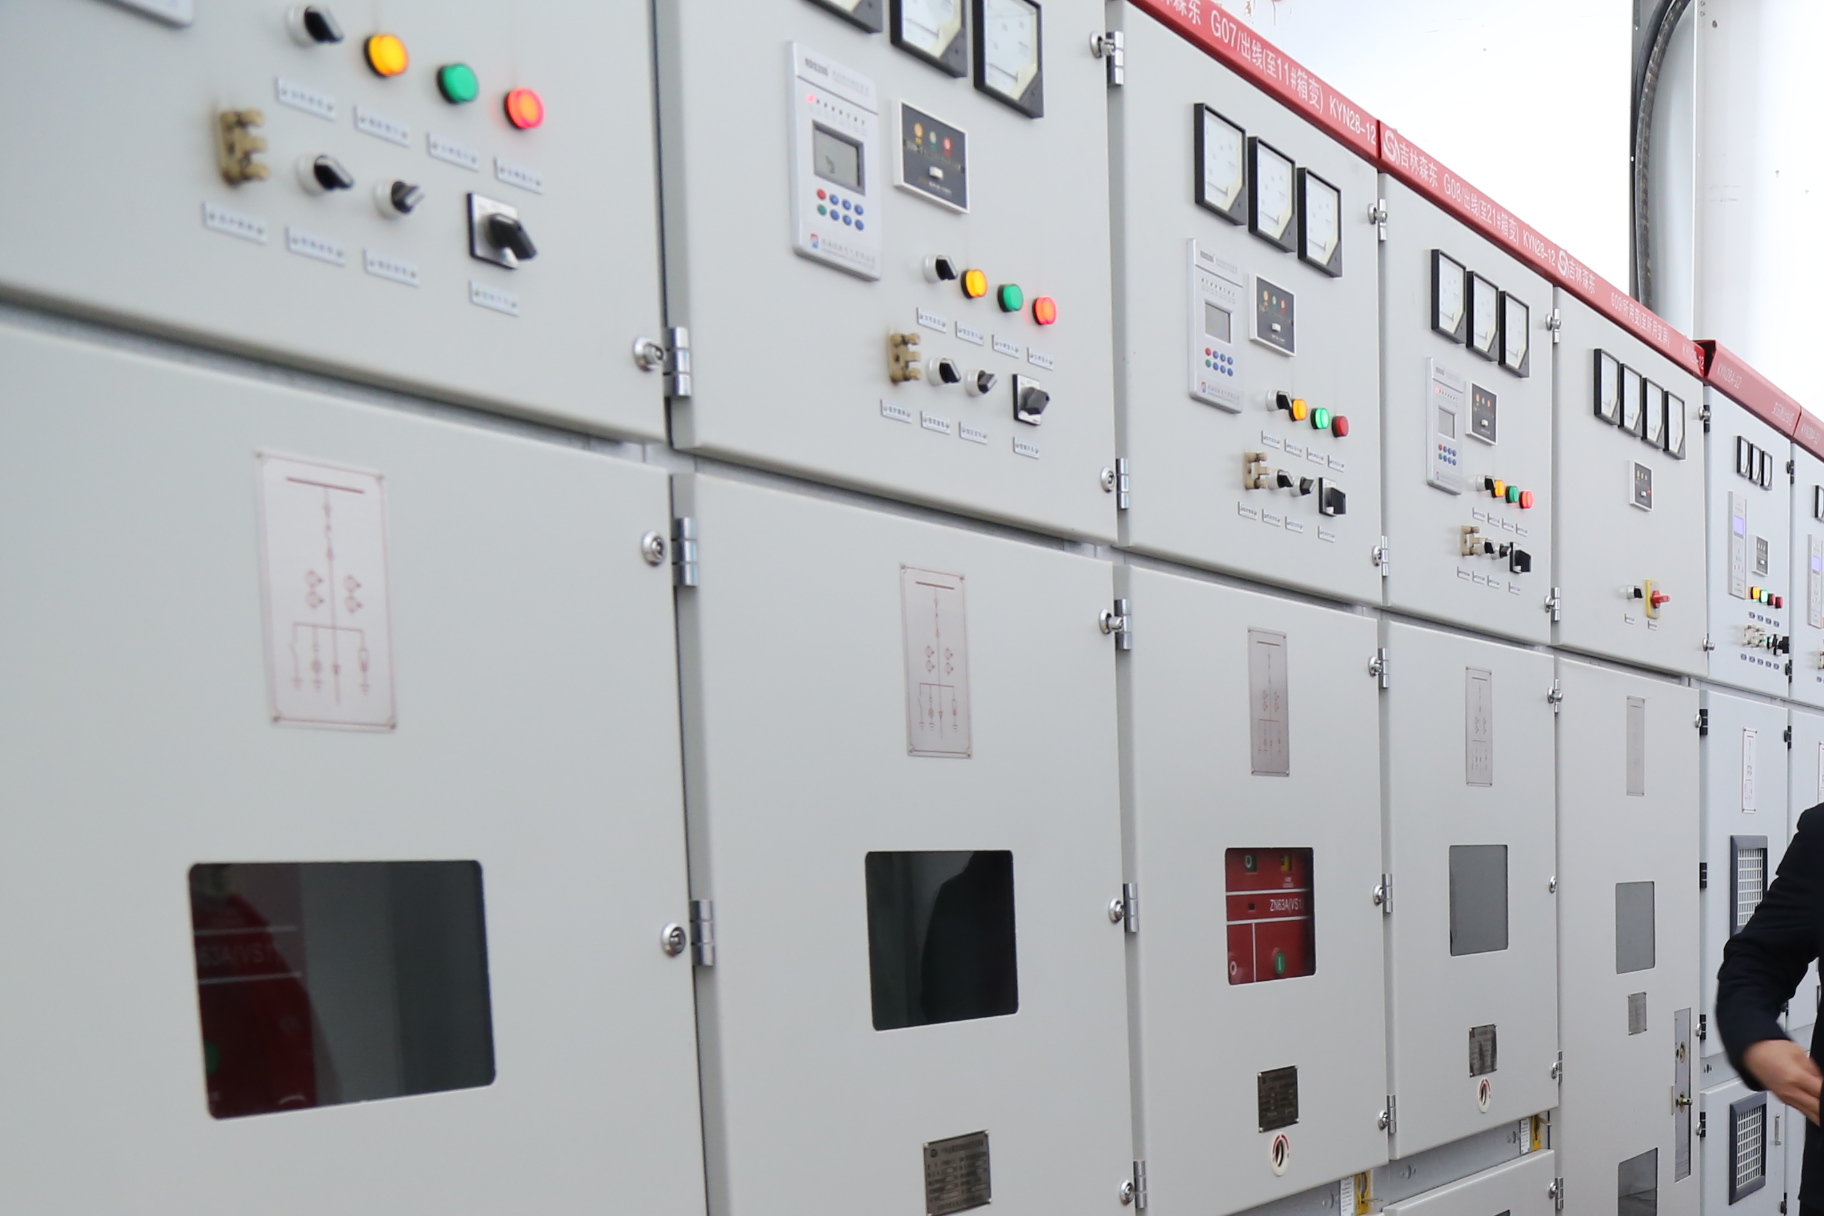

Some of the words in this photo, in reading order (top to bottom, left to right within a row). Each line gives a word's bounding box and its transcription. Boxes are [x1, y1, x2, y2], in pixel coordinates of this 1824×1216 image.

[1329, 95, 1377, 146] KYN28-12
[1399, 142, 1438, 188] 吉林森东
